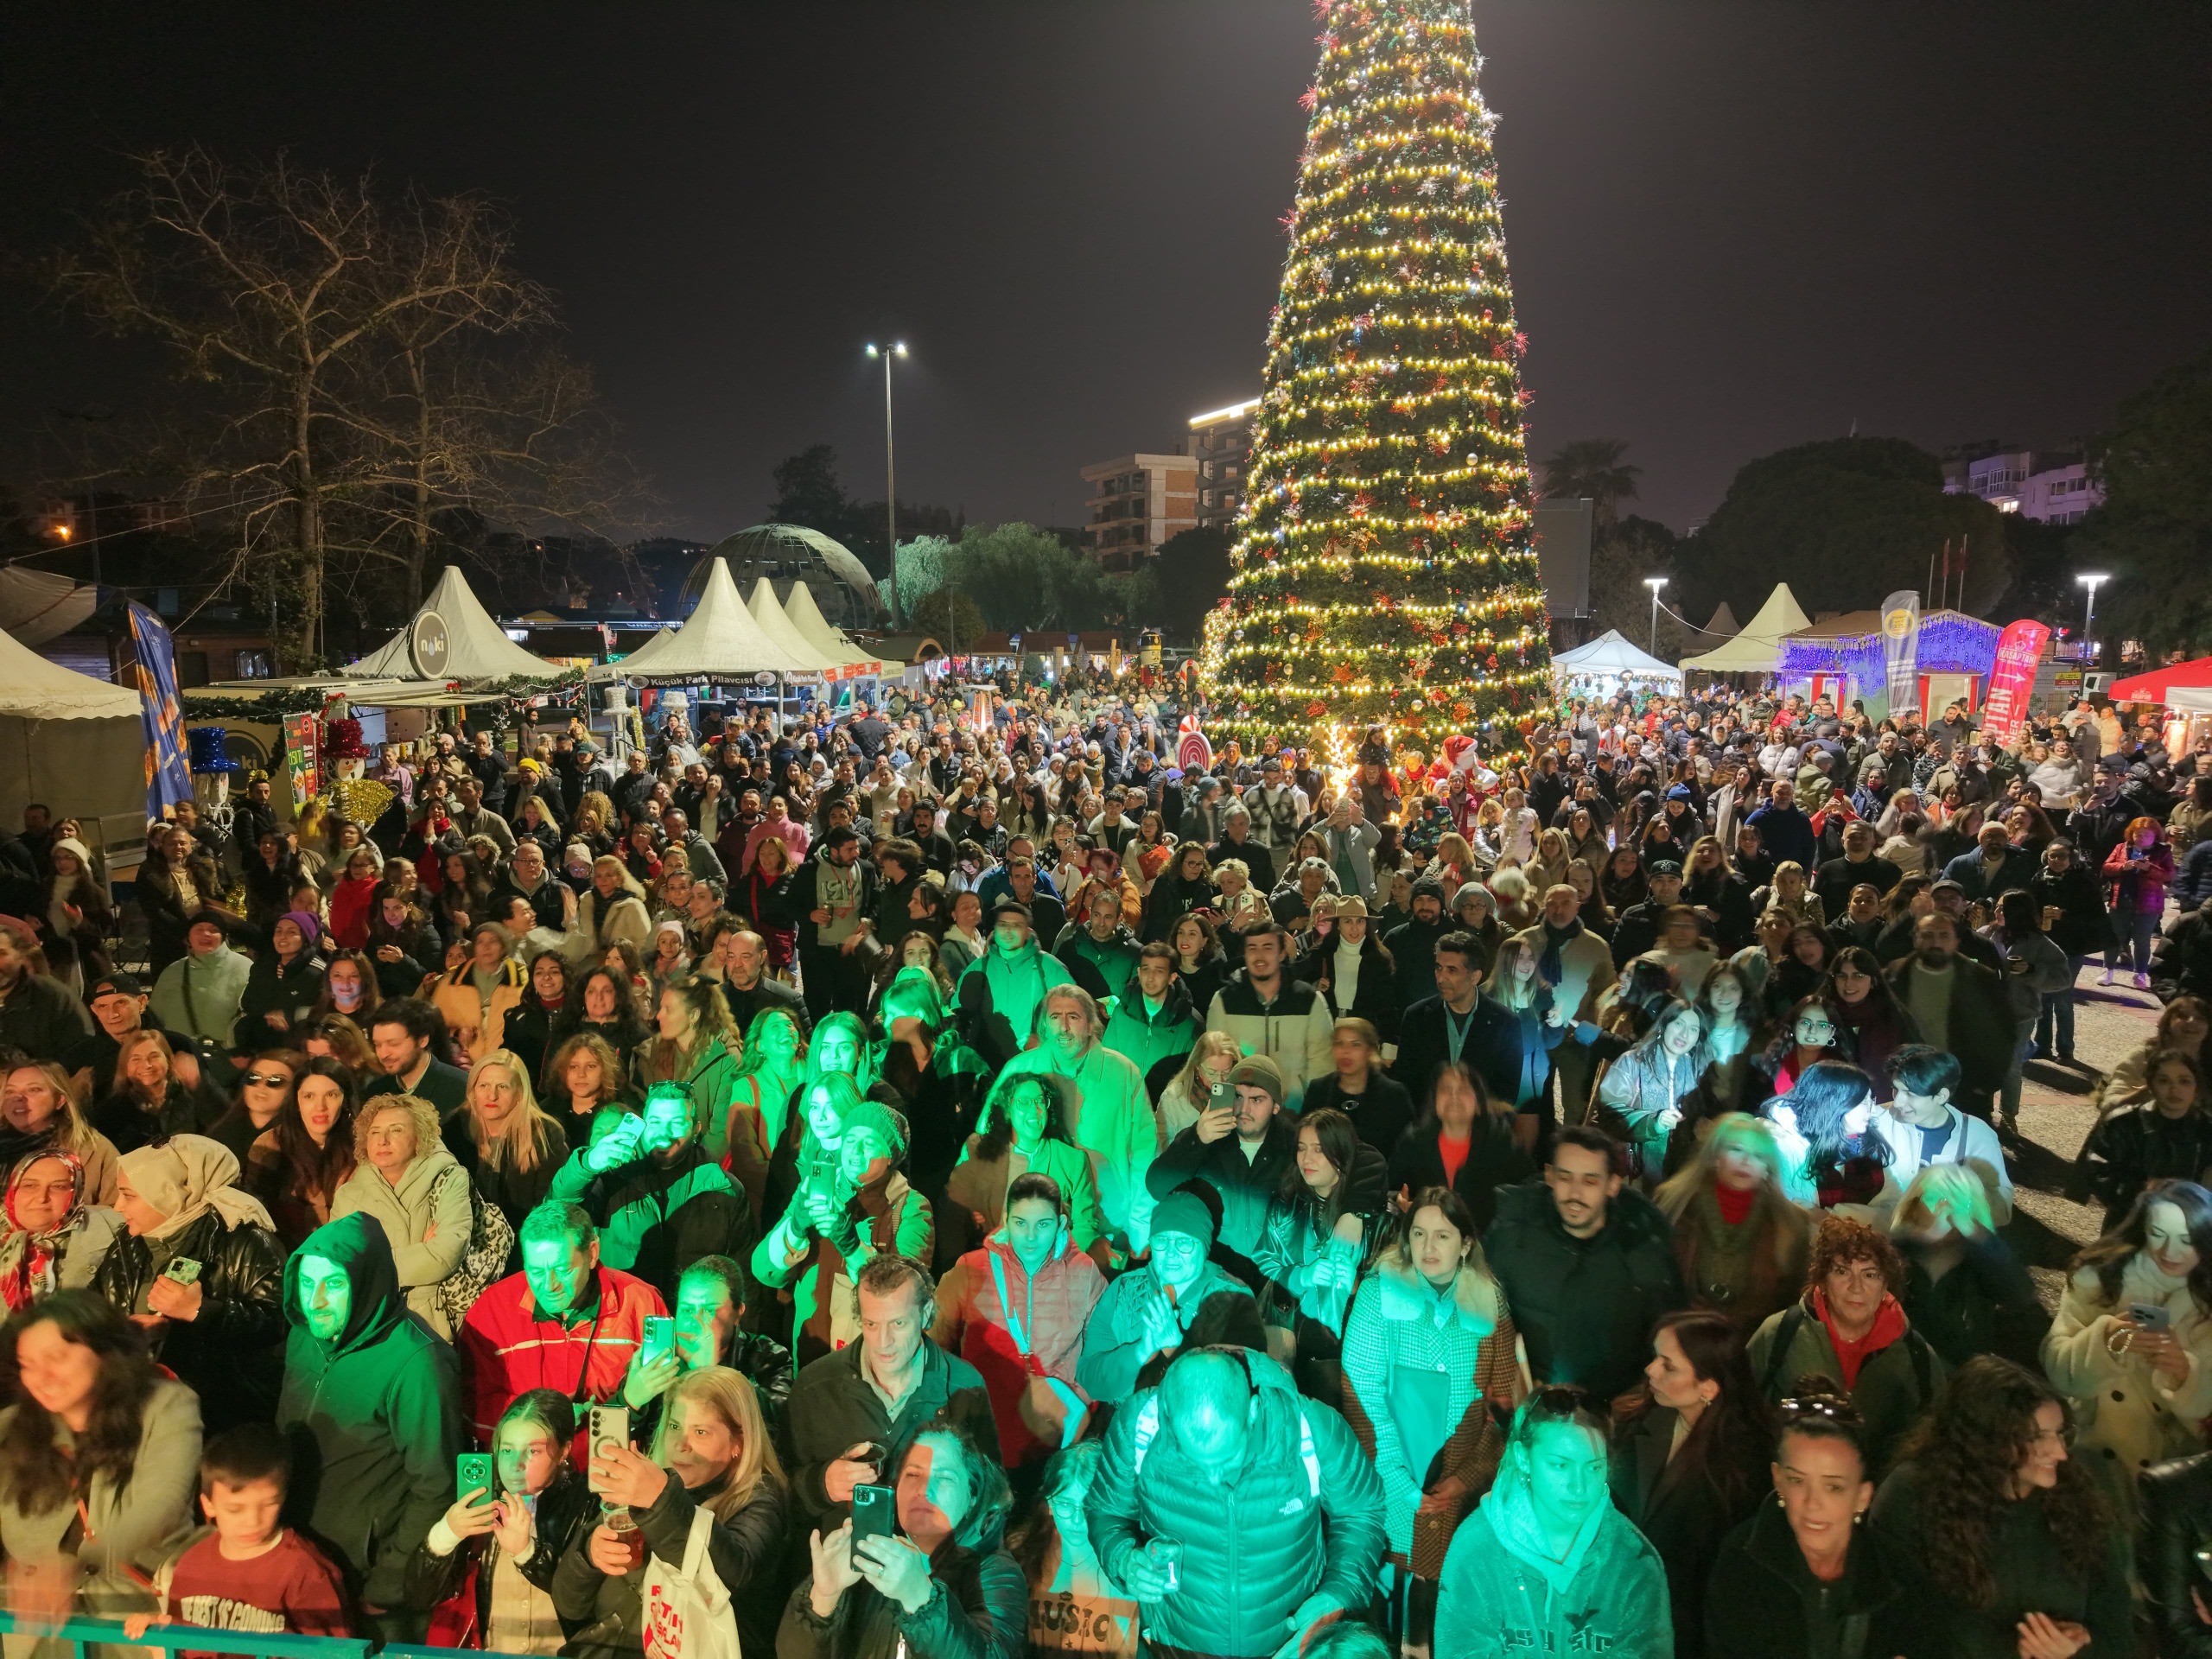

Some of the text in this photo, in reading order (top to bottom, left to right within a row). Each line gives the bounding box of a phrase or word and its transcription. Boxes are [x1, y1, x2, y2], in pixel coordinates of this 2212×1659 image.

[1999, 650, 2035, 664] KASAPTAN
[651, 677, 683, 687] Küçük
[685, 675, 709, 684] Park
[227, 1601, 285, 1633] COMING
